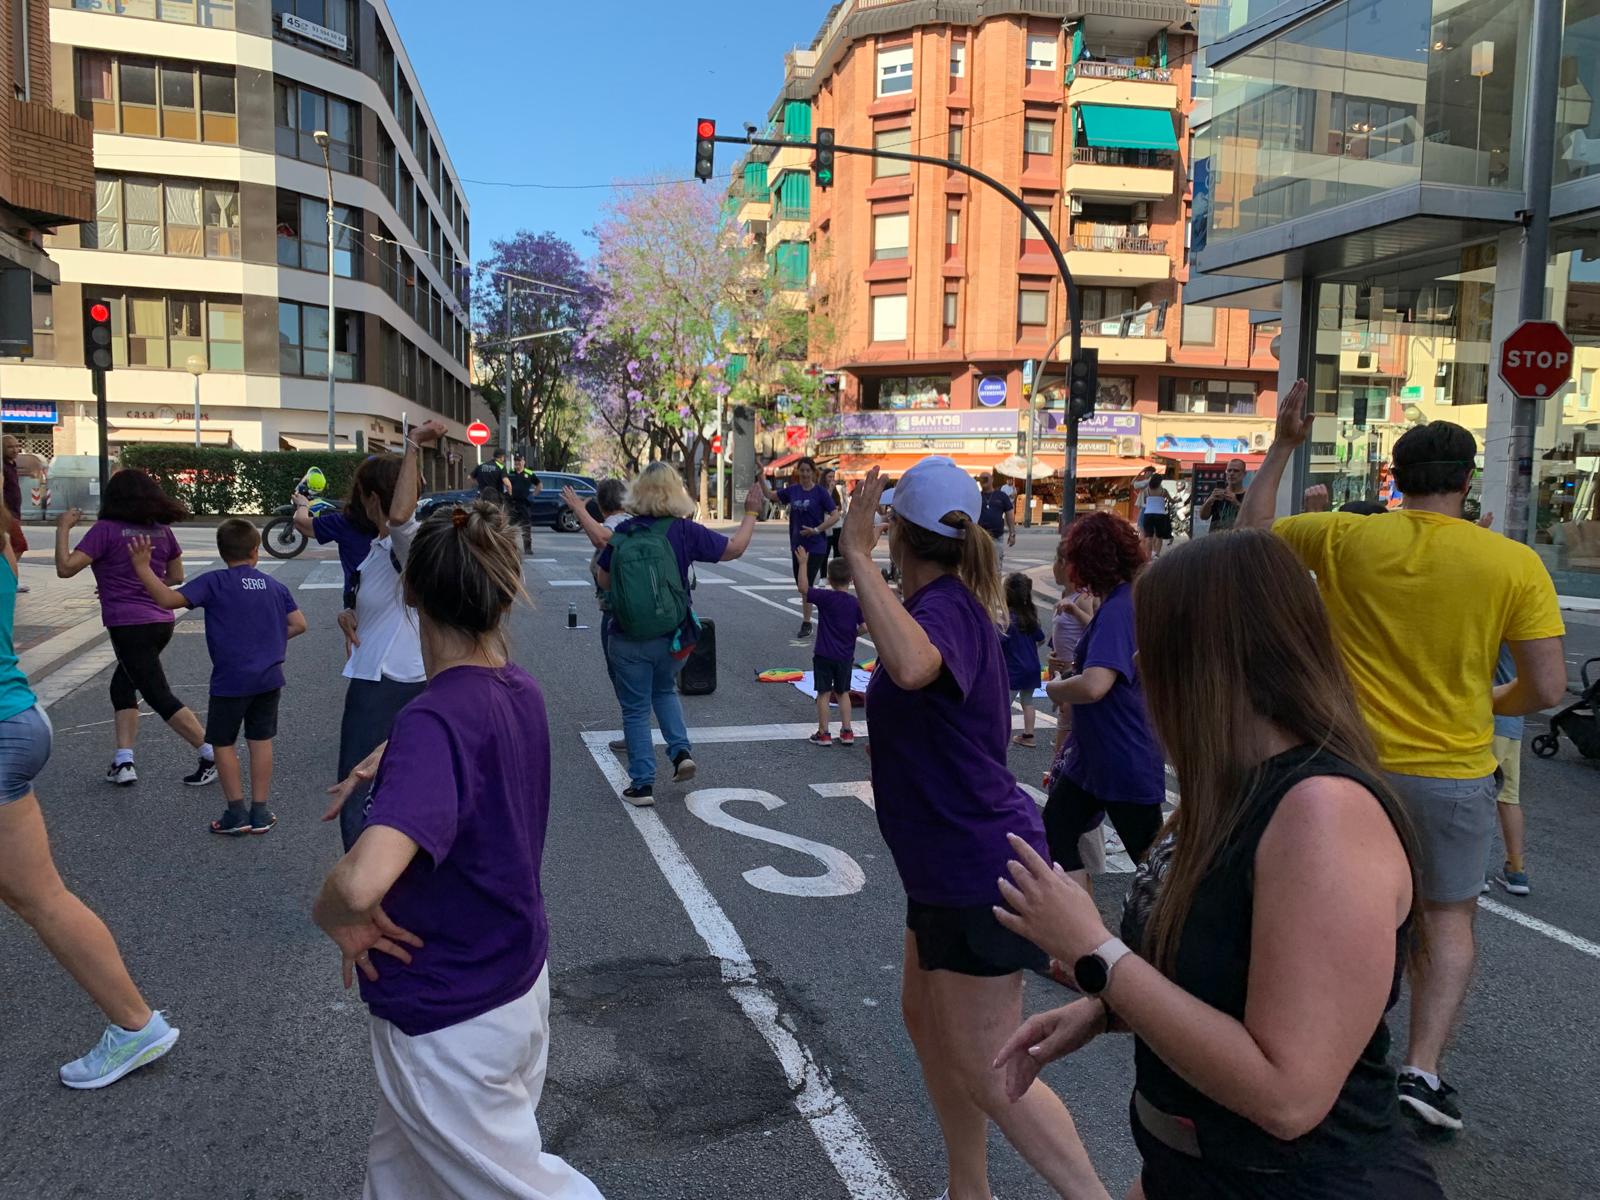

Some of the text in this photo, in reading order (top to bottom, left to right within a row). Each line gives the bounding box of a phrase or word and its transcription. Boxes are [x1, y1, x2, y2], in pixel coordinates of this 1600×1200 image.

[1506, 350, 1569, 369] STOP
[126, 410, 155, 419] casa
[911, 415, 961, 426] SANTOS
[241, 577, 267, 591] SERGI
